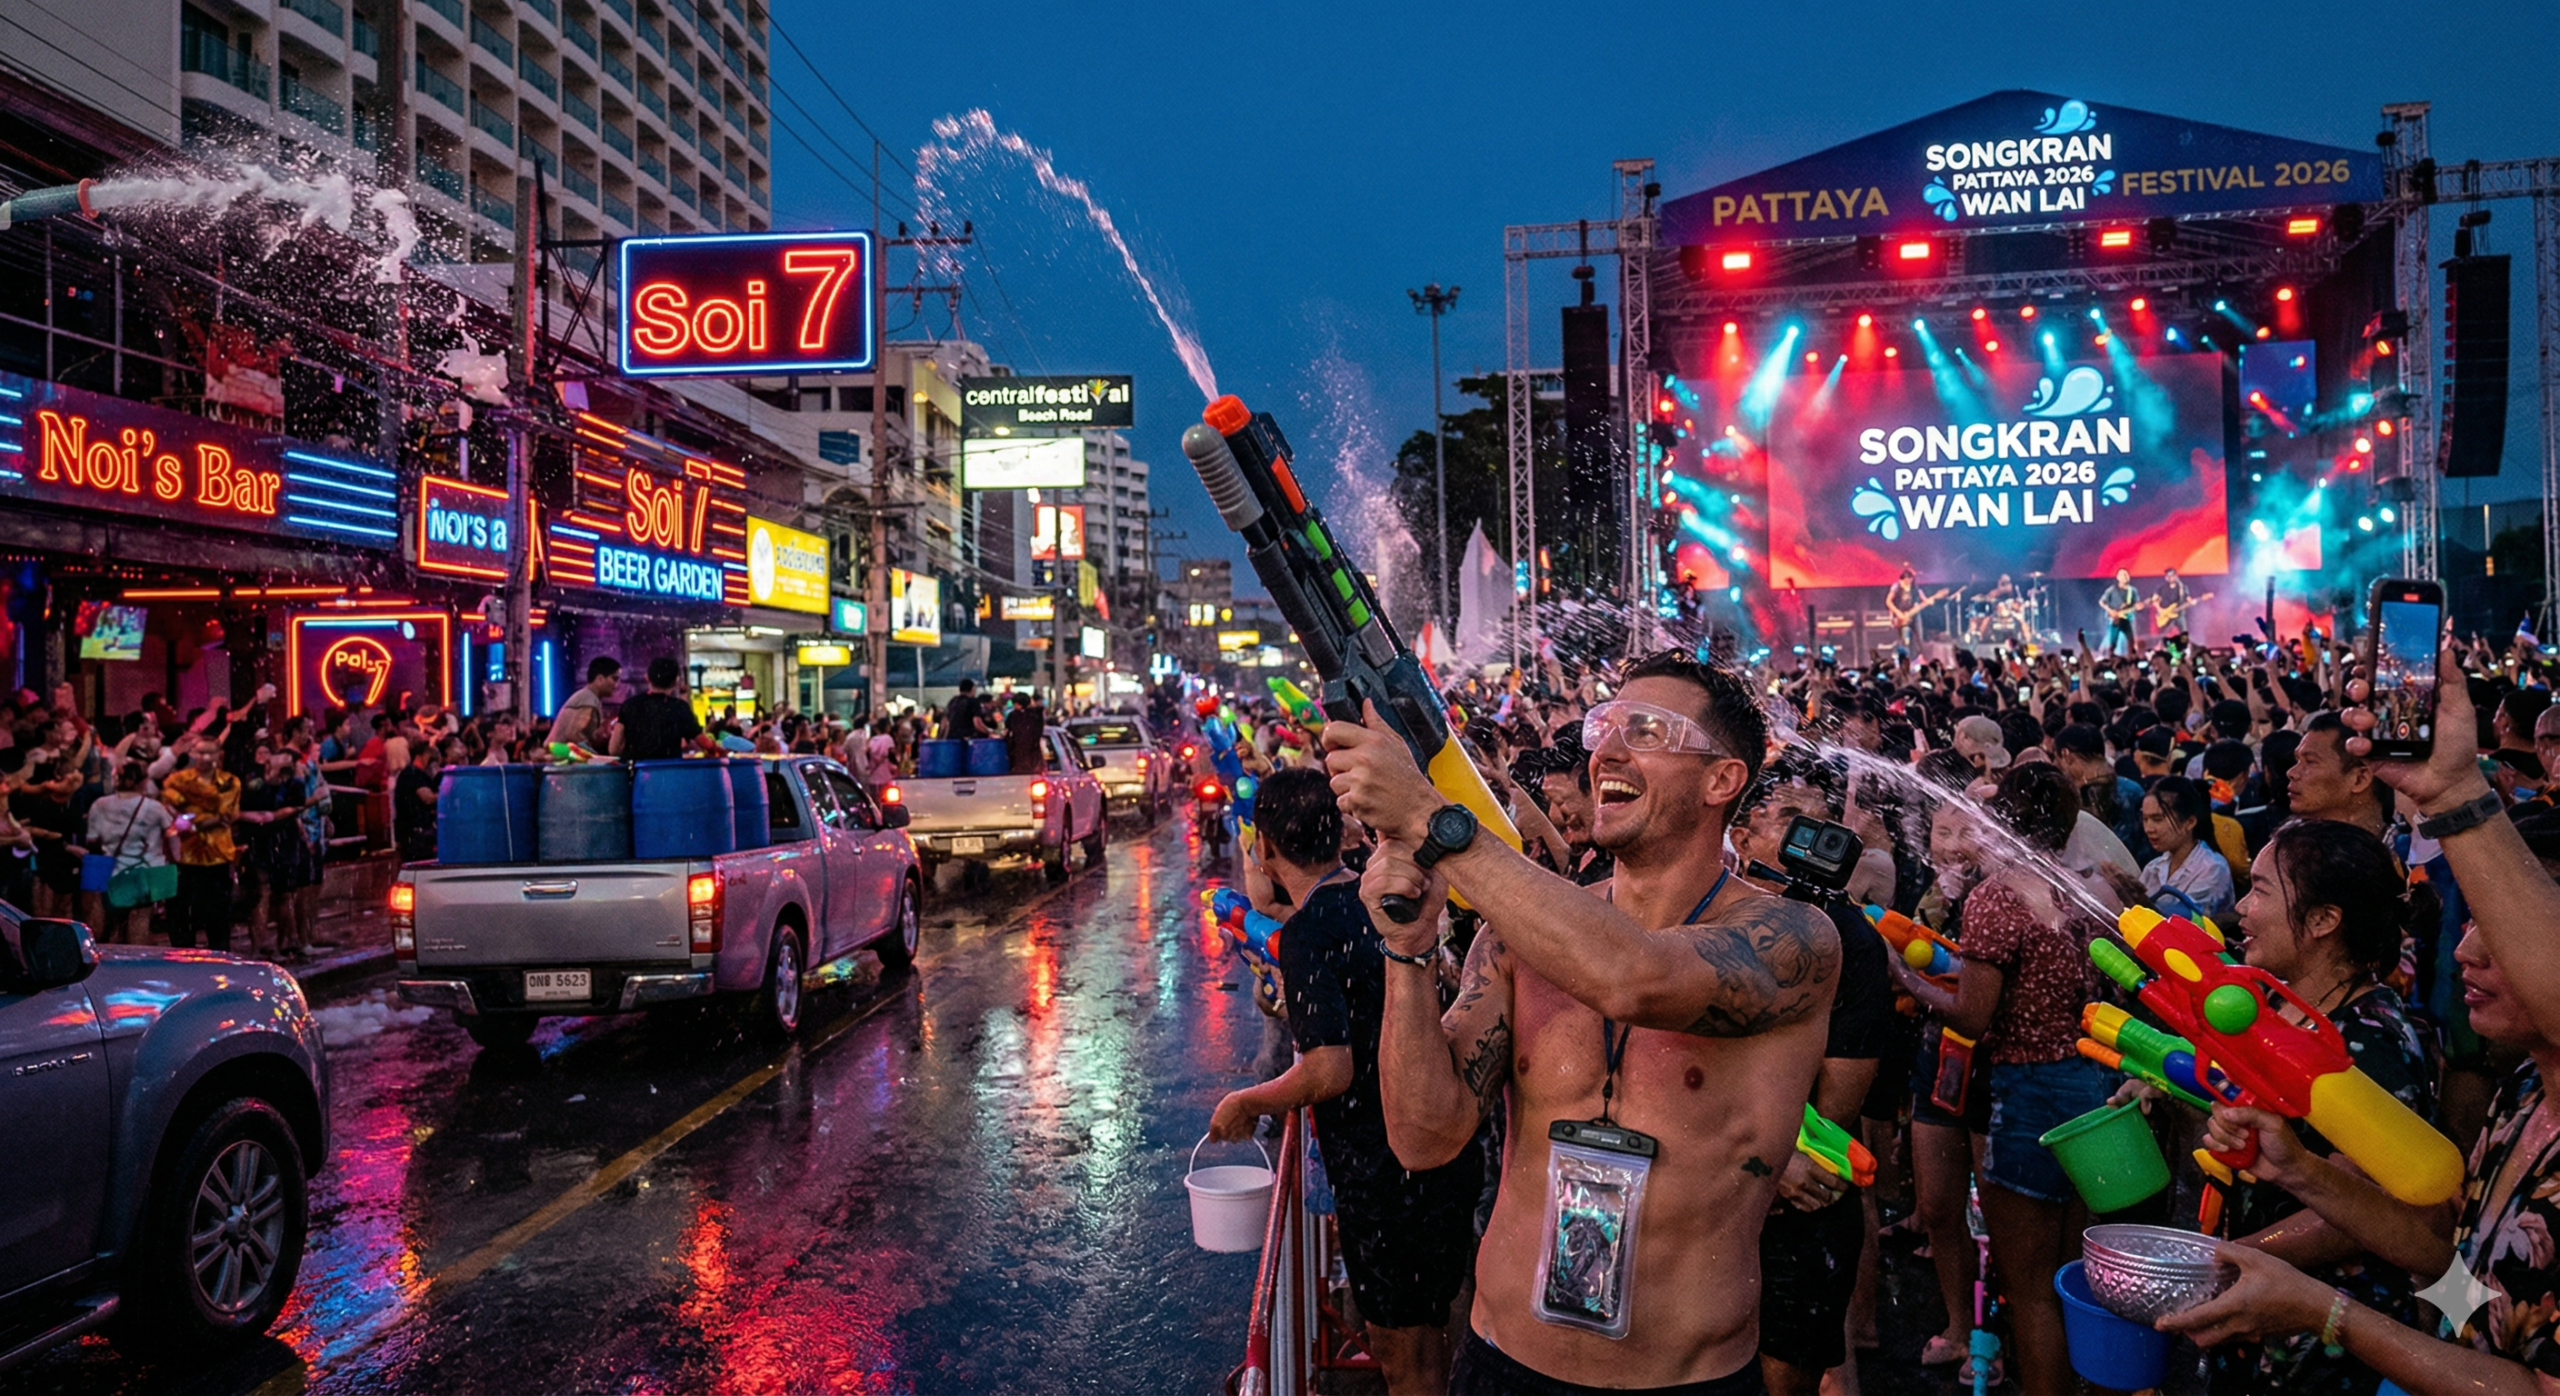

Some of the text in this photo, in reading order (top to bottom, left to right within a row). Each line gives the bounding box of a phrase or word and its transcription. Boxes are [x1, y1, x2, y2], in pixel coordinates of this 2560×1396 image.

[1926, 133, 2113, 172] SONGKRAN
[1952, 164, 2096, 191] PATTAYA 2026
[2122, 159, 2351, 196] FESTIVAL 2026
[1712, 186, 1890, 227] PATTAYA
[1960, 186, 2086, 217] WAN LAI
[633, 249, 855, 354] Soi 7
[1858, 416, 2131, 465] SONGKRAN
[39, 410, 281, 515] Noi's Bar
[1894, 460, 2097, 491] PATTAYA 2026
[626, 458, 712, 554] Soi 7
[1898, 488, 2094, 530] WAN LAI
[598, 546, 651, 592] BEER
[652, 557, 724, 601] GARDEN
[555, 972, 588, 988] 5623
